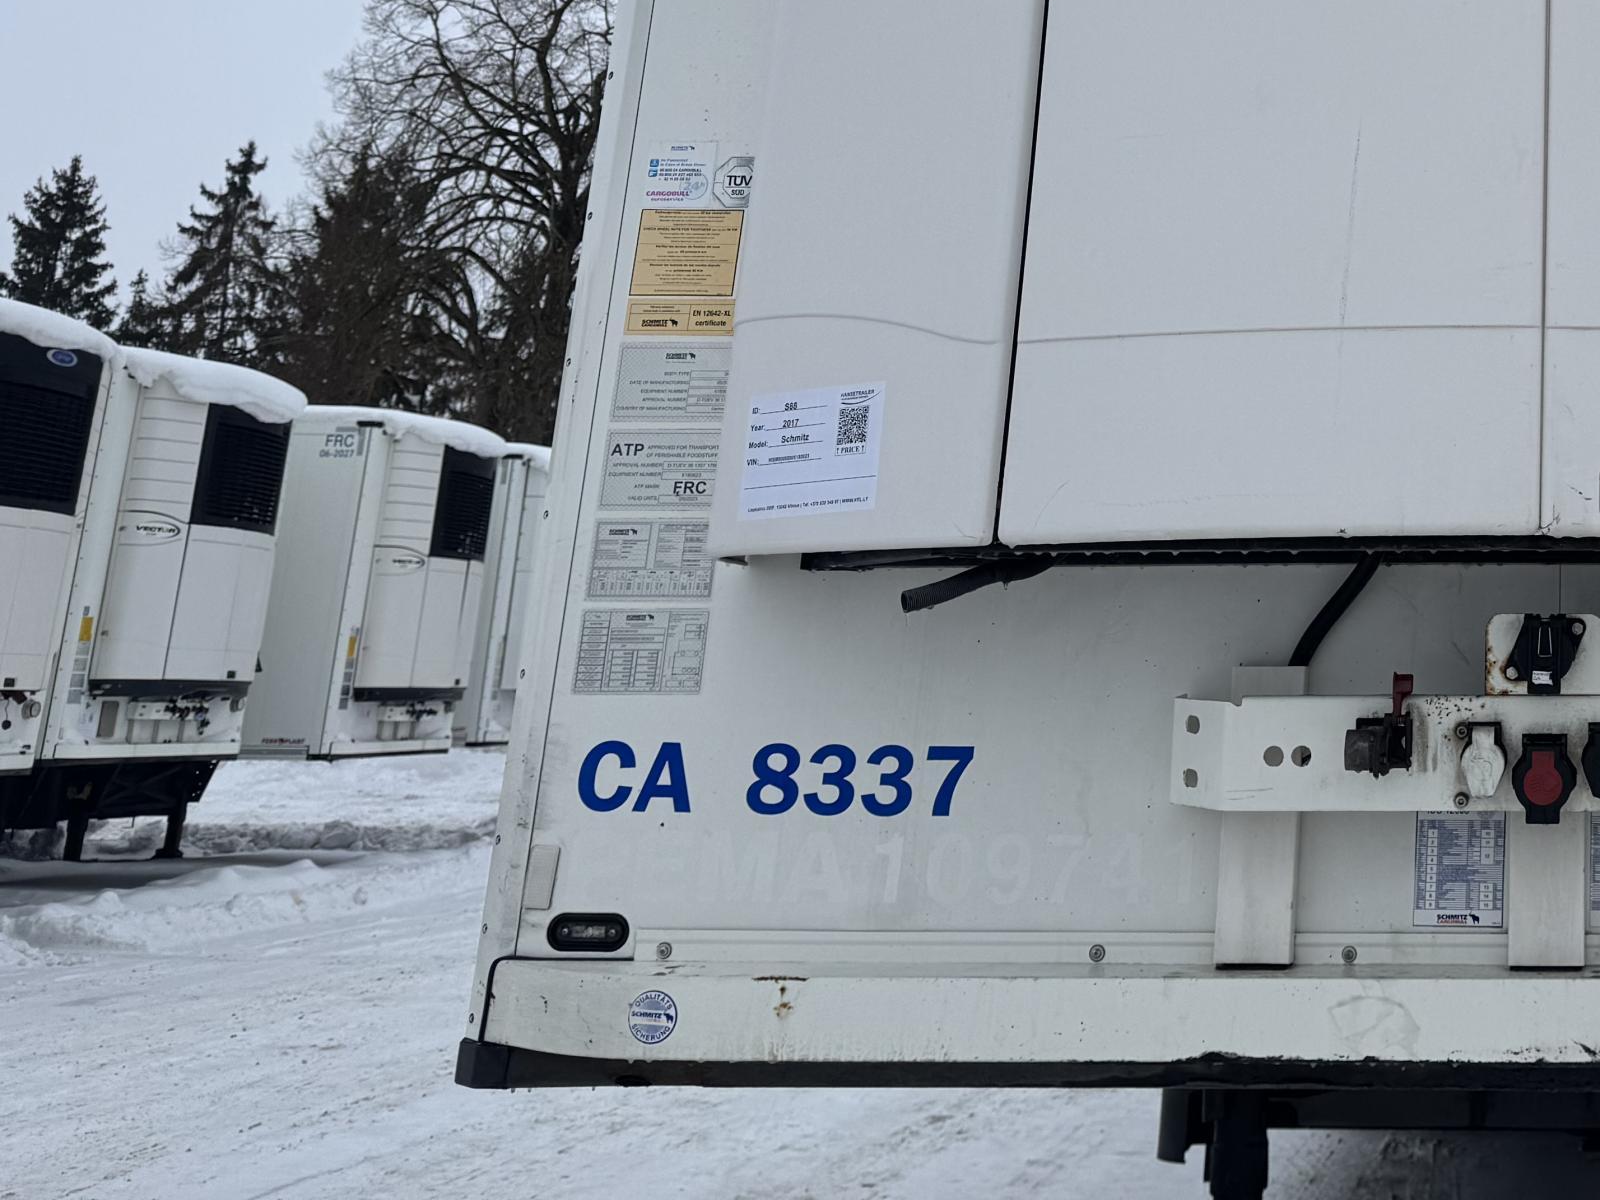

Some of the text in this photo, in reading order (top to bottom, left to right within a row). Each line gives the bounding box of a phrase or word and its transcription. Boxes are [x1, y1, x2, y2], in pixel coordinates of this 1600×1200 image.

[782, 418, 799, 428] 2017
[325, 434, 354, 448] FRC
[748, 433, 810, 449] Model: Schmitz
[611, 443, 645, 456] ATP
[673, 481, 707, 494] FRC
[577, 740, 975, 817] CA 8337
[631, 1011, 662, 1019] SCHMITZ
[631, 1023, 670, 1041] SICHERUNG
